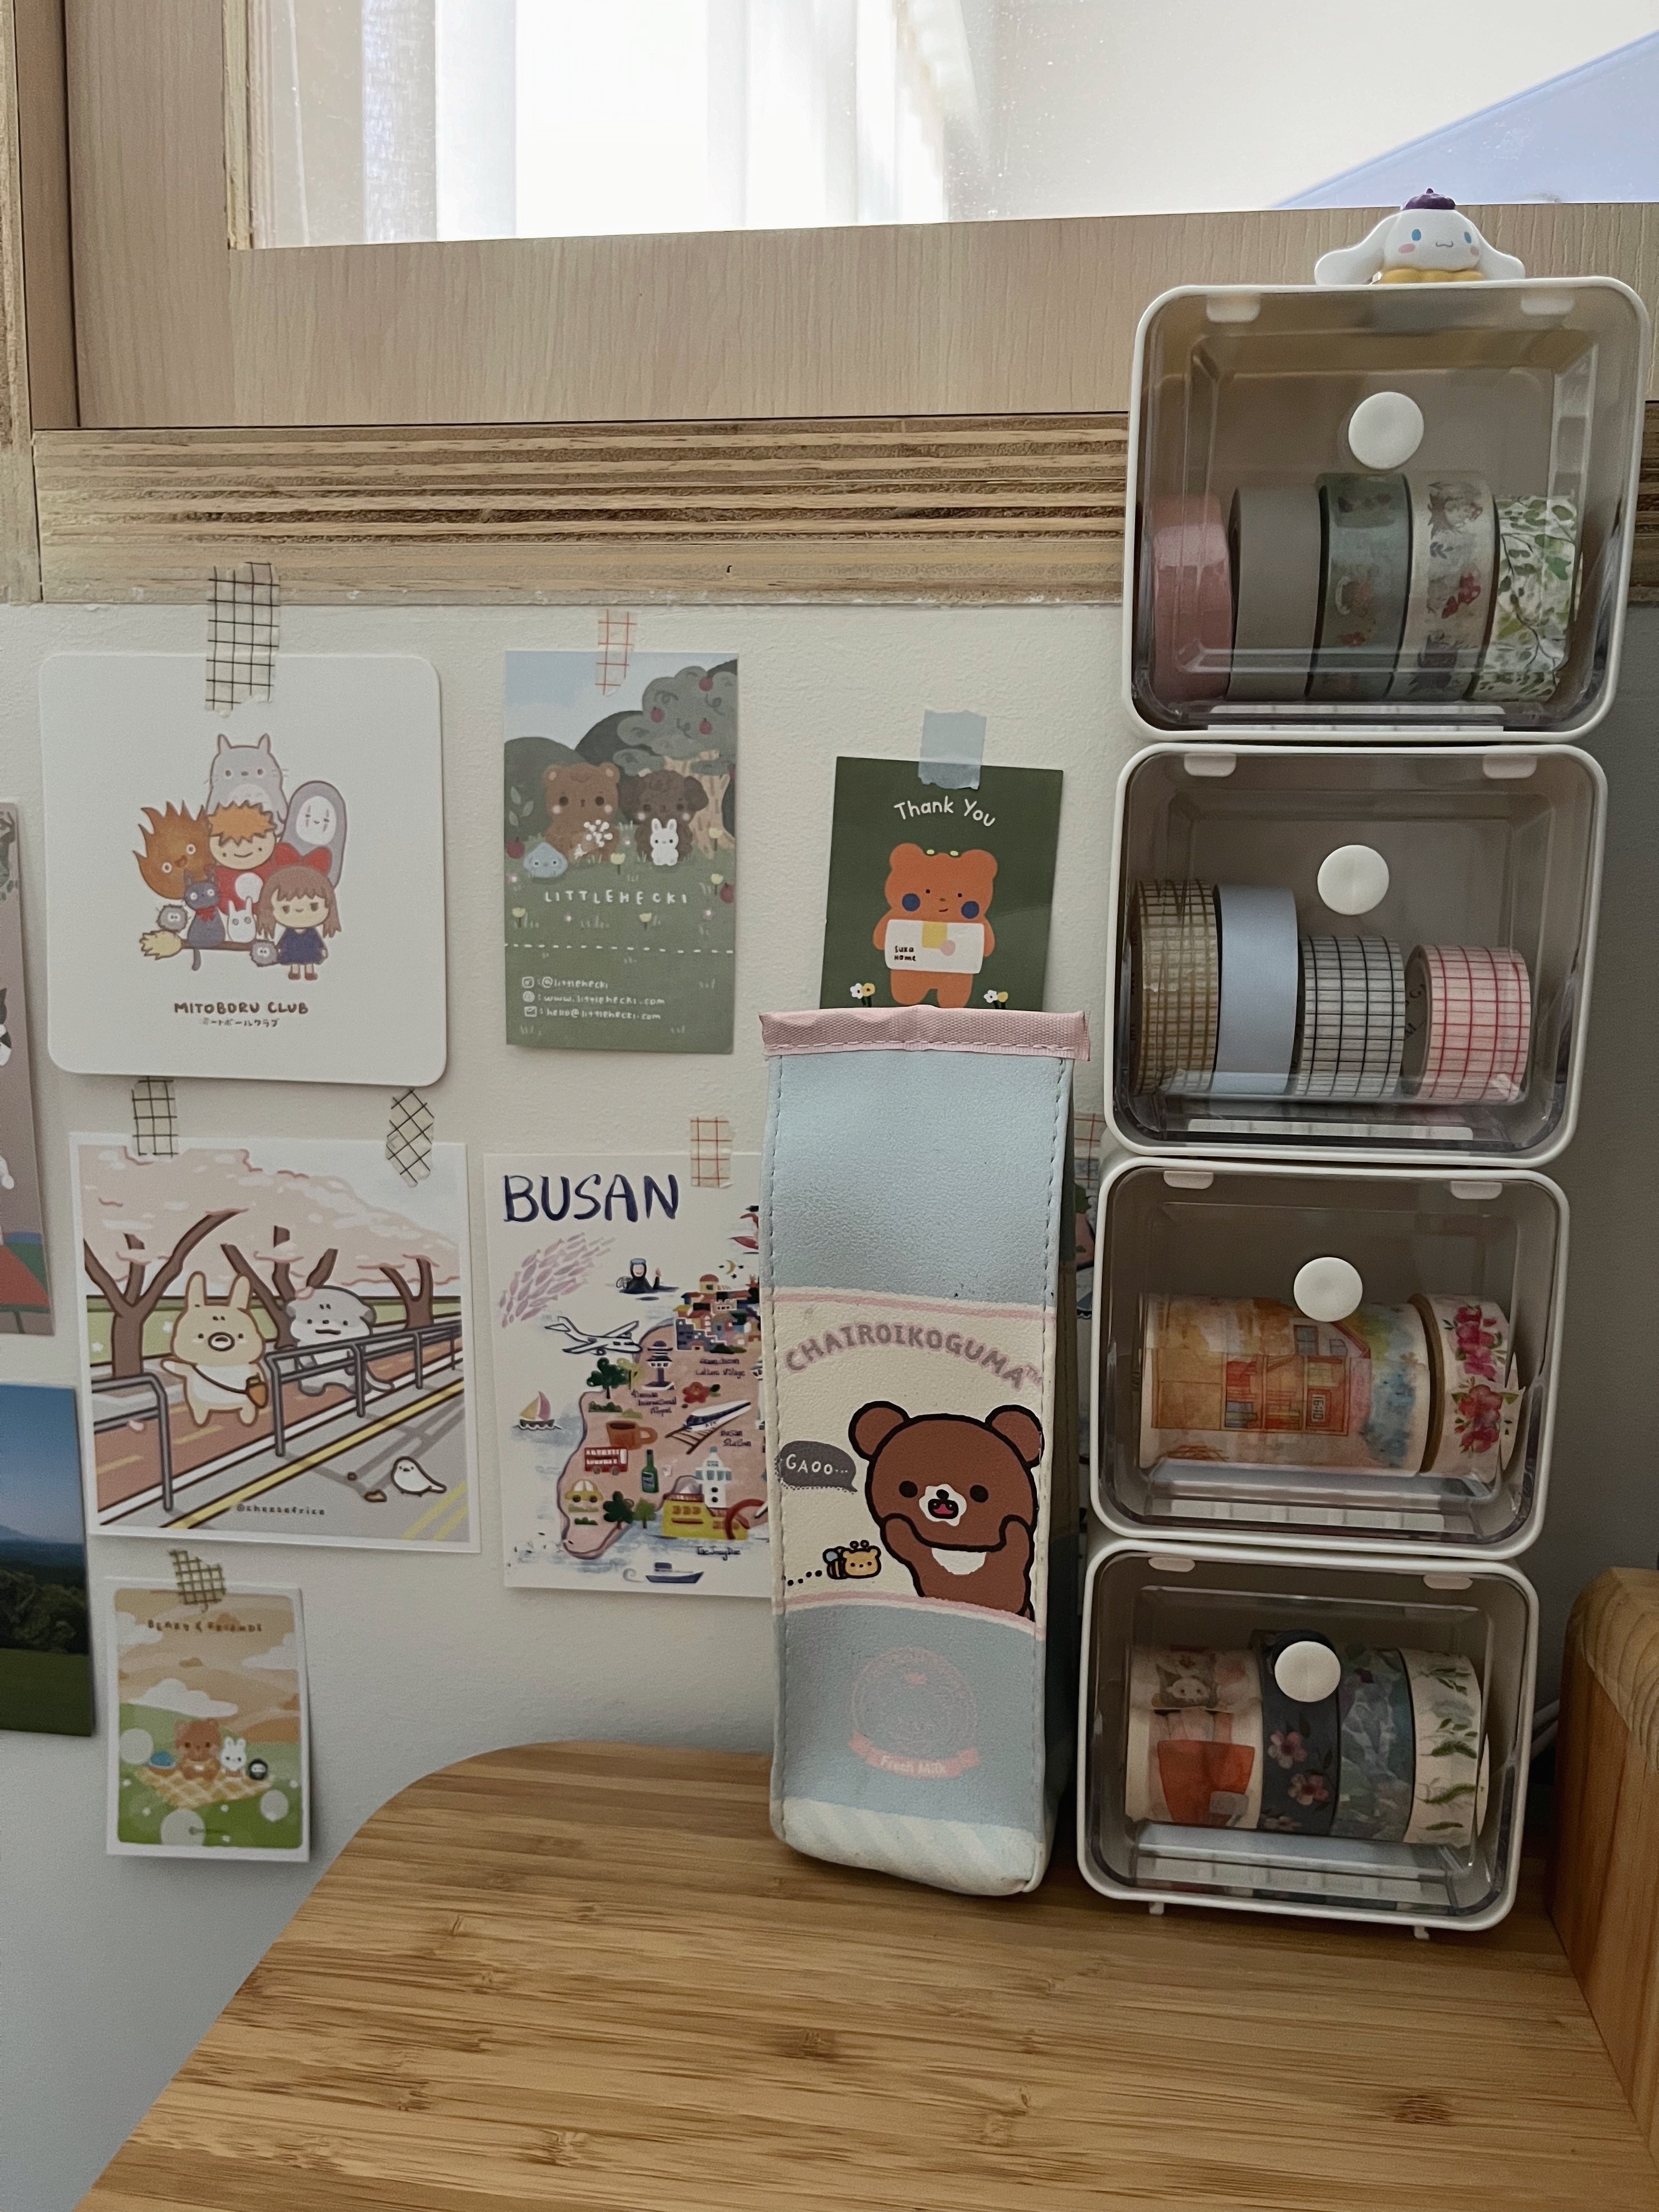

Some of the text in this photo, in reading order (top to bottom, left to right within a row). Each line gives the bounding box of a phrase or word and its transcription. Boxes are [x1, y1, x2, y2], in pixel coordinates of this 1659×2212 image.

[894, 795, 996, 827] Thank You
[545, 889, 687, 905] LITTLEHECKI
[268, 1002, 309, 1014] CLUB
[504, 1173, 679, 1223] BUSAN
[785, 1322, 1025, 1390] CHAIROIKOGUMA
